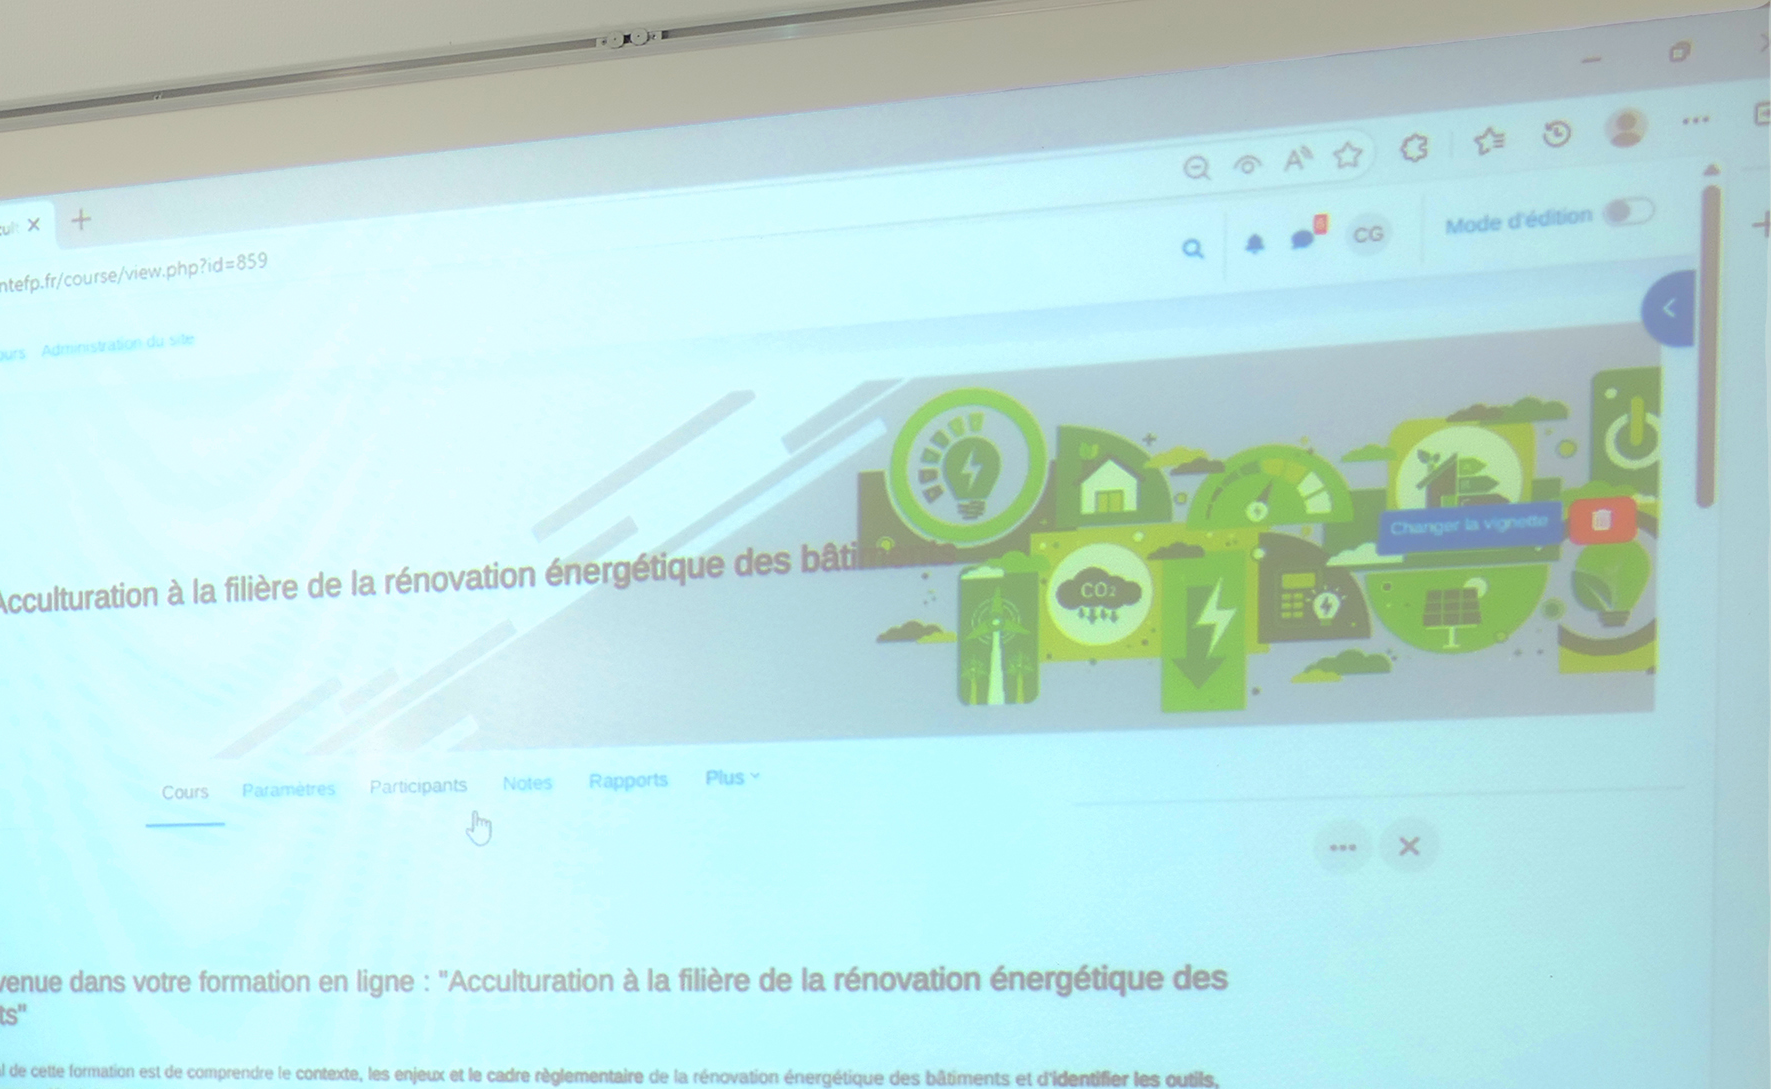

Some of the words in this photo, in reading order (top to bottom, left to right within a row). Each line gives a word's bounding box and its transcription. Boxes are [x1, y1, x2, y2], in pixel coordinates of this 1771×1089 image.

[1353, 225, 1385, 244] CG
[1446, 216, 1501, 236] Mode
[1508, 205, 1593, 230] d'édition
[41, 336, 143, 358] Administration
[146, 334, 165, 348] du
[169, 332, 195, 346] site
[1390, 515, 1460, 538] Changer
[1465, 513, 1480, 531] la
[1483, 510, 1549, 535] vignette
[166, 578, 185, 606] à
[192, 574, 218, 605] la
[224, 571, 299, 603] filière
[307, 570, 342, 600] de
[351, 570, 376, 596] la
[384, 559, 536, 596] rénovation
[544, 550, 725, 591] énergétique
[734, 547, 792, 577] des
[161, 784, 209, 802] Cours
[241, 779, 336, 799] Paramètres
[369, 776, 468, 797] Participants
[503, 774, 553, 793] Notes
[589, 771, 668, 793] Rapports
[705, 768, 745, 787] Plus
[69, 968, 126, 994] dans
[132, 970, 192, 995] votre
[198, 968, 312, 995] formation
[317, 974, 350, 995] en
[355, 967, 415, 998] ligne
[437, 966, 615, 993] "Acculturation
[623, 968, 641, 993] à
[646, 966, 670, 992] la
[678, 966, 751, 993] filière
[758, 965, 794, 993] de
[801, 966, 827, 992] la
[833, 966, 982, 993] rénovation
[989, 964, 1165, 997] énergétique
[1172, 964, 1229, 992] des
[9, 1063, 27, 1078] de
[31, 1063, 65, 1079] cette
[68, 1063, 135, 1079] formation
[139, 1066, 161, 1080] est
[164, 1064, 183, 1080] de
[186, 1065, 274, 1084] comprendre
[278, 1066, 292, 1080] le
[295, 1067, 364, 1084] contexte,
[368, 1066, 390, 1081] les
[393, 1067, 446, 1086] enjeux
[449, 1068, 465, 1083] et
[468, 1067, 483, 1083] le
[486, 1067, 530, 1083] cadre
[648, 1069, 670, 1085] de
[673, 1069, 689, 1085] la
[692, 1069, 780, 1086] rénovation
[783, 1068, 885, 1089] énergétique
[889, 1070, 921, 1086] des
[926, 1070, 1010, 1087] bâtiments
[1015, 1072, 1032, 1087] et
[1036, 1071, 1130, 1088] d'identifier
[1133, 1072, 1161, 1088] les
